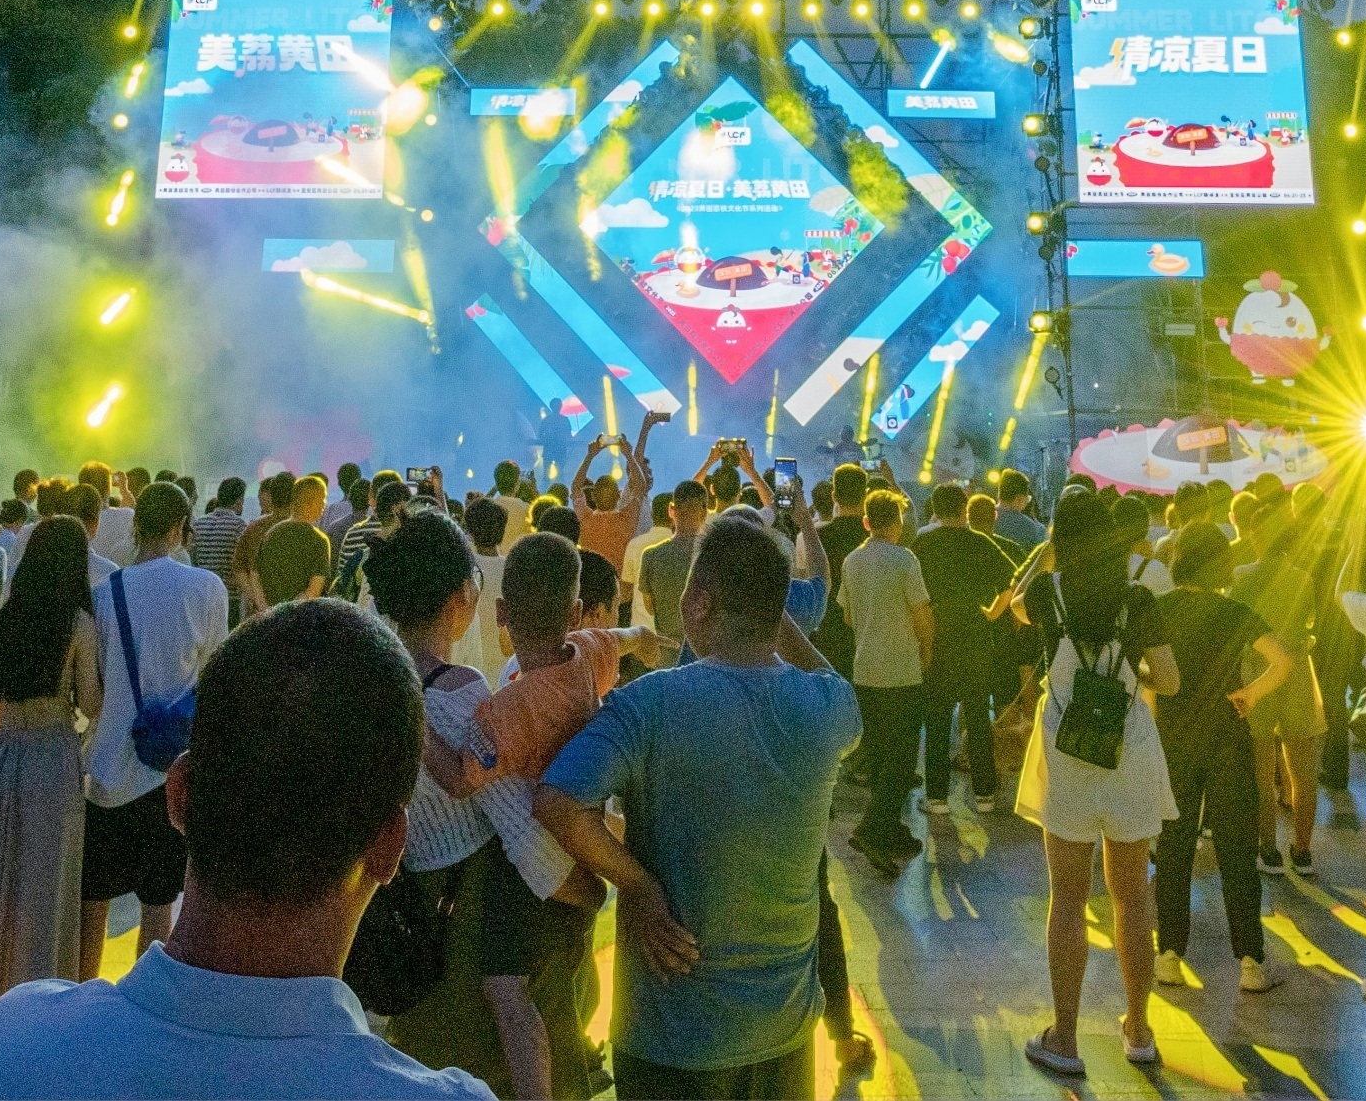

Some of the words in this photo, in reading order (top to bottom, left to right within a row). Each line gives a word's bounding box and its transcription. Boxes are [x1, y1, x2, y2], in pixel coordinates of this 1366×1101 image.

[196, 33, 356, 76] 美荔黄田
[1110, 35, 1268, 81] 清凉夏日
